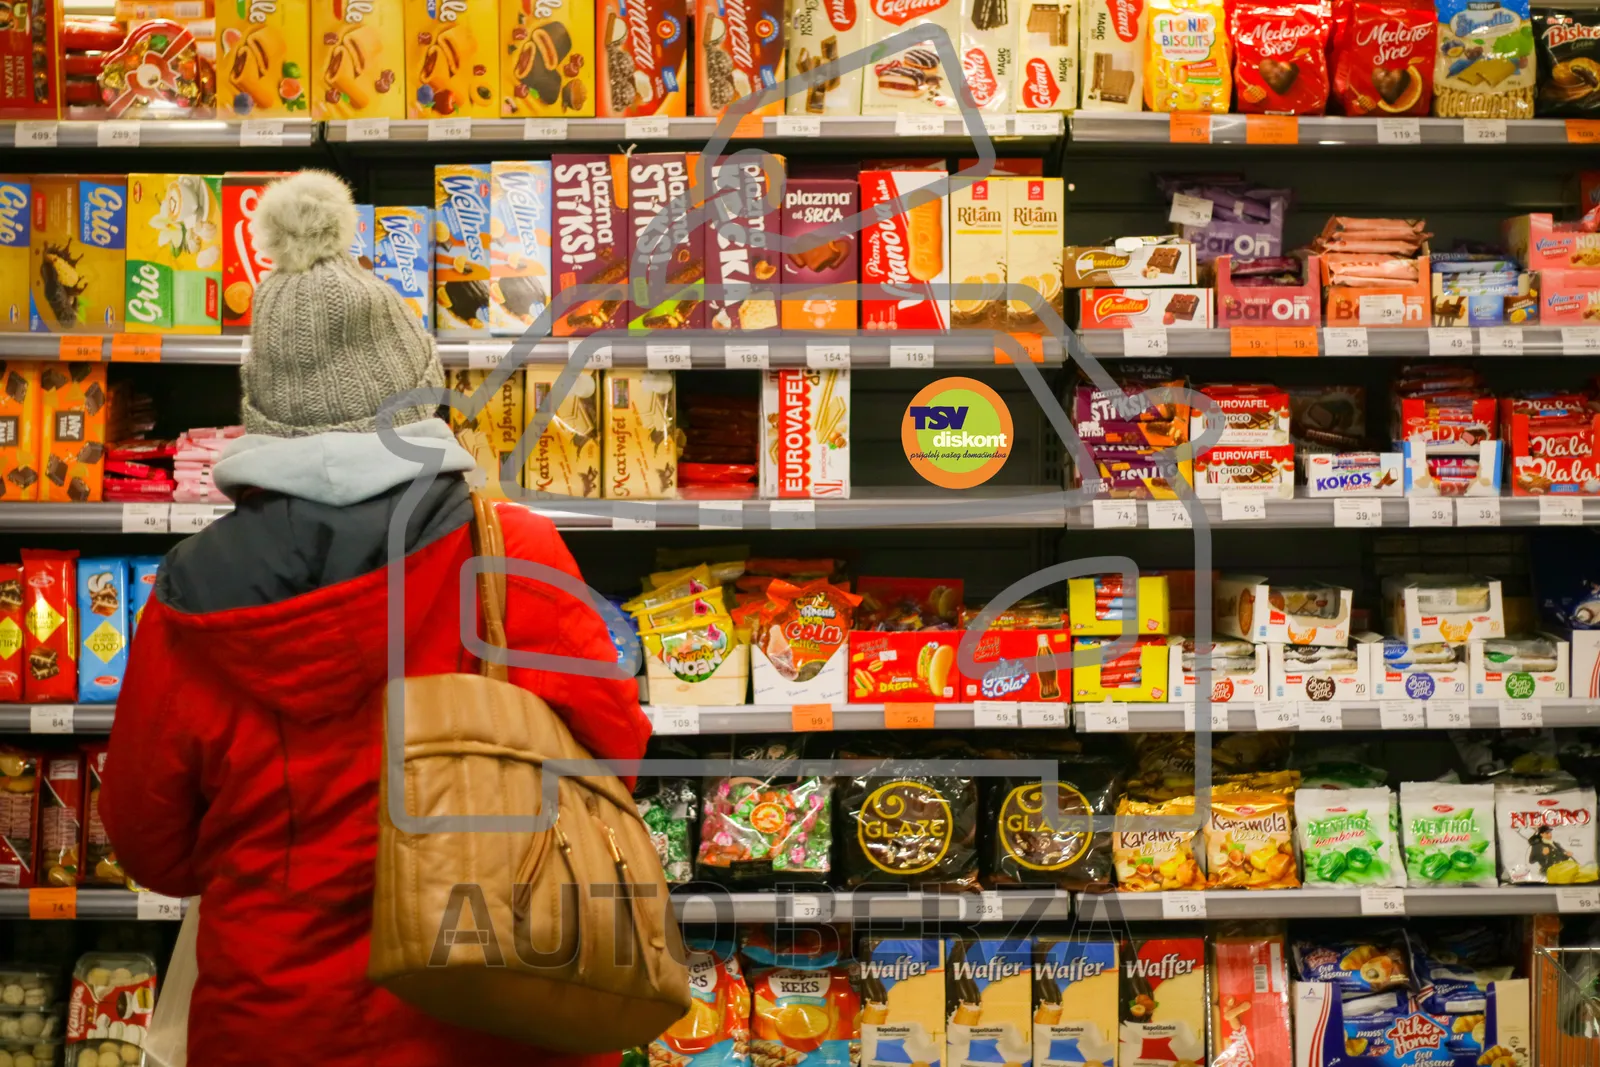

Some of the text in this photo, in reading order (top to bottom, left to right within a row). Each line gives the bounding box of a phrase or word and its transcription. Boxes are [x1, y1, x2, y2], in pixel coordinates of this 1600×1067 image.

[1097, 13, 1106, 40] MAGIC
[1159, 18, 1209, 32] PIONIR
[1238, 20, 1315, 41] Medeno
[1356, 22, 1433, 46] Medeno
[1162, 34, 1210, 47] BISCUITS
[997, 48, 1006, 75] MAGIC
[1373, 43, 1413, 66] Srce
[1059, 57, 1068, 82] MAGIC
[1032, 62, 1051, 108] Gerard
[587, 161, 614, 245] plazma
[662, 161, 690, 245] plazma
[786, 190, 851, 206] plazma
[88, 187, 123, 246] Gric
[442, 174, 489, 261] Wellness
[497, 171, 538, 258] Wellness
[804, 207, 843, 223] SRCA
[380, 216, 419, 292] Wellness
[128, 264, 160, 323] Gric
[1226, 298, 1310, 320] BarOn
[1210, 400, 1269, 409] EUROVAFEL
[67, 415, 81, 439] MY
[786, 369, 804, 491] EUROVAFEL
[612, 417, 633, 497] Maxivafel
[1212, 450, 1272, 460] EUROVAFEL
[1220, 467, 1253, 475] CHOCO
[1316, 472, 1373, 492] KOKOS
[785, 621, 843, 645] Cola
[93, 643, 118, 652] COCO
[993, 677, 1023, 697] Cola
[1408, 675, 1431, 689] Bon
[1455, 683, 1465, 692] 20
[1508, 675, 1531, 688] Bon
[1555, 682, 1565, 692] 20
[865, 820, 945, 838] GLAZE
[1211, 811, 1287, 832] Karamela
[1411, 817, 1480, 835] MENTHOL
[1510, 807, 1590, 829] NEGRO
[1315, 829, 1366, 848] bombone
[1419, 832, 1471, 847] bombone
[860, 955, 929, 981] Waffer
[953, 955, 1024, 982] Waffer
[1034, 956, 1104, 982] Waffer
[1126, 952, 1197, 979] Waffer
[781, 981, 820, 993] KEKS
[1142, 1024, 1176, 1032] Napolitanke
[1393, 1035, 1439, 1059] Home
